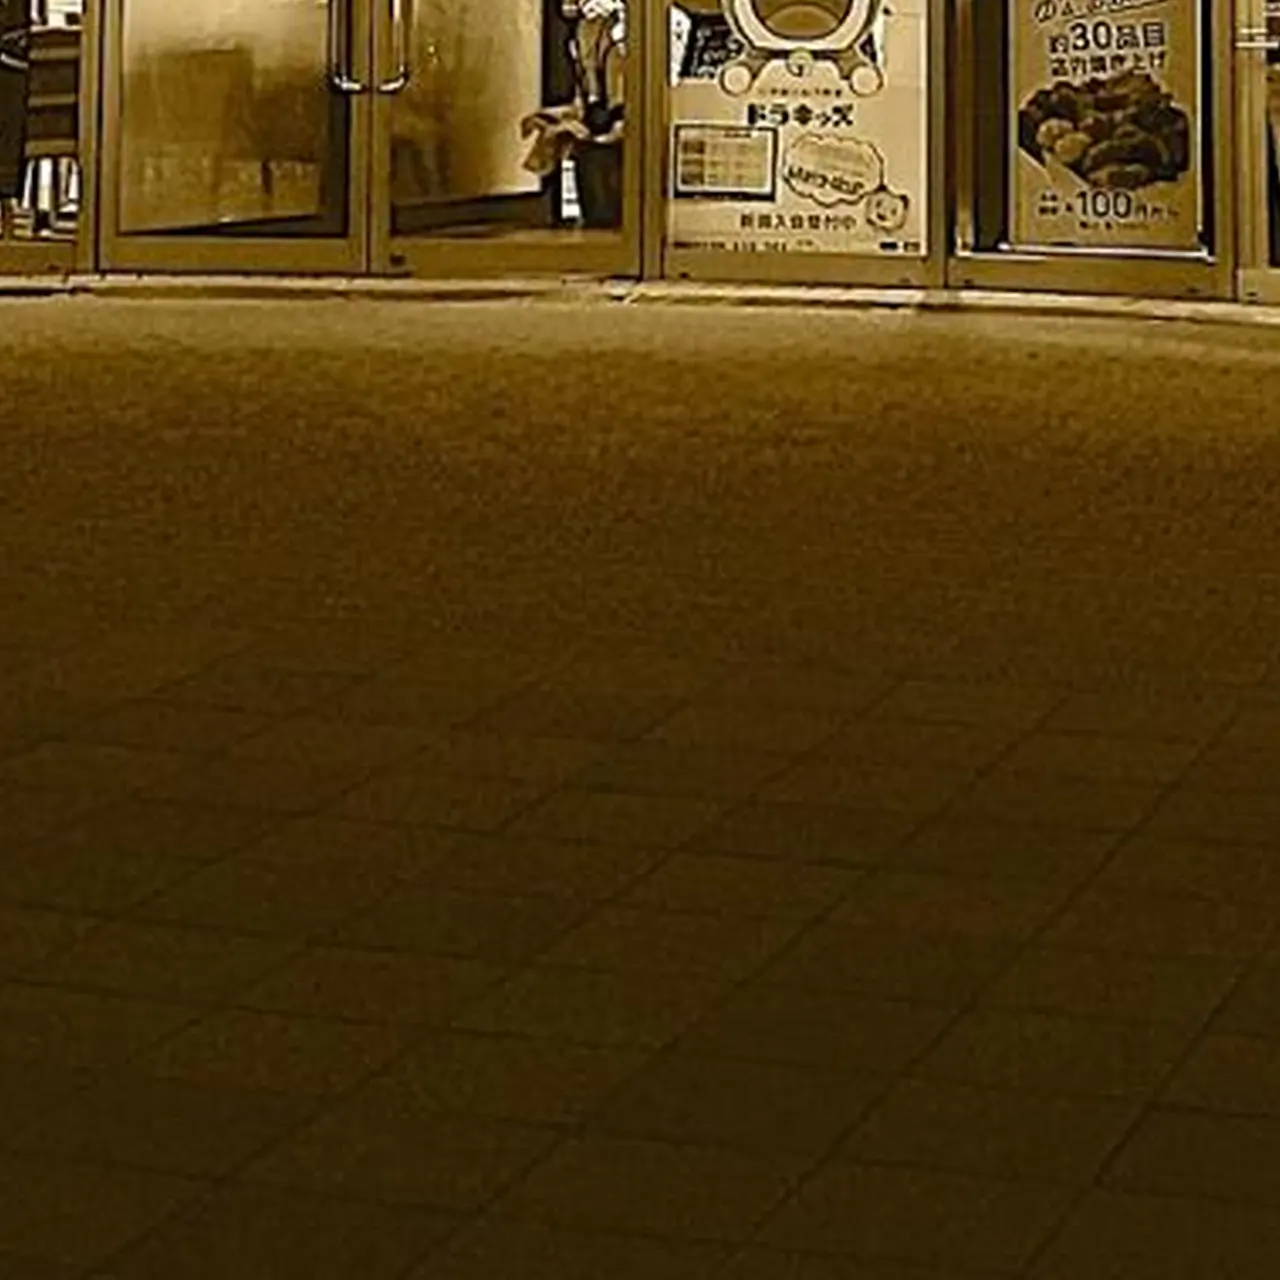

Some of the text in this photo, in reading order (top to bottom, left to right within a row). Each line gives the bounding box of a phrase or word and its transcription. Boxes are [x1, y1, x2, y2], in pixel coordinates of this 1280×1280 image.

[746, 102, 854, 127] ドラキッズ
